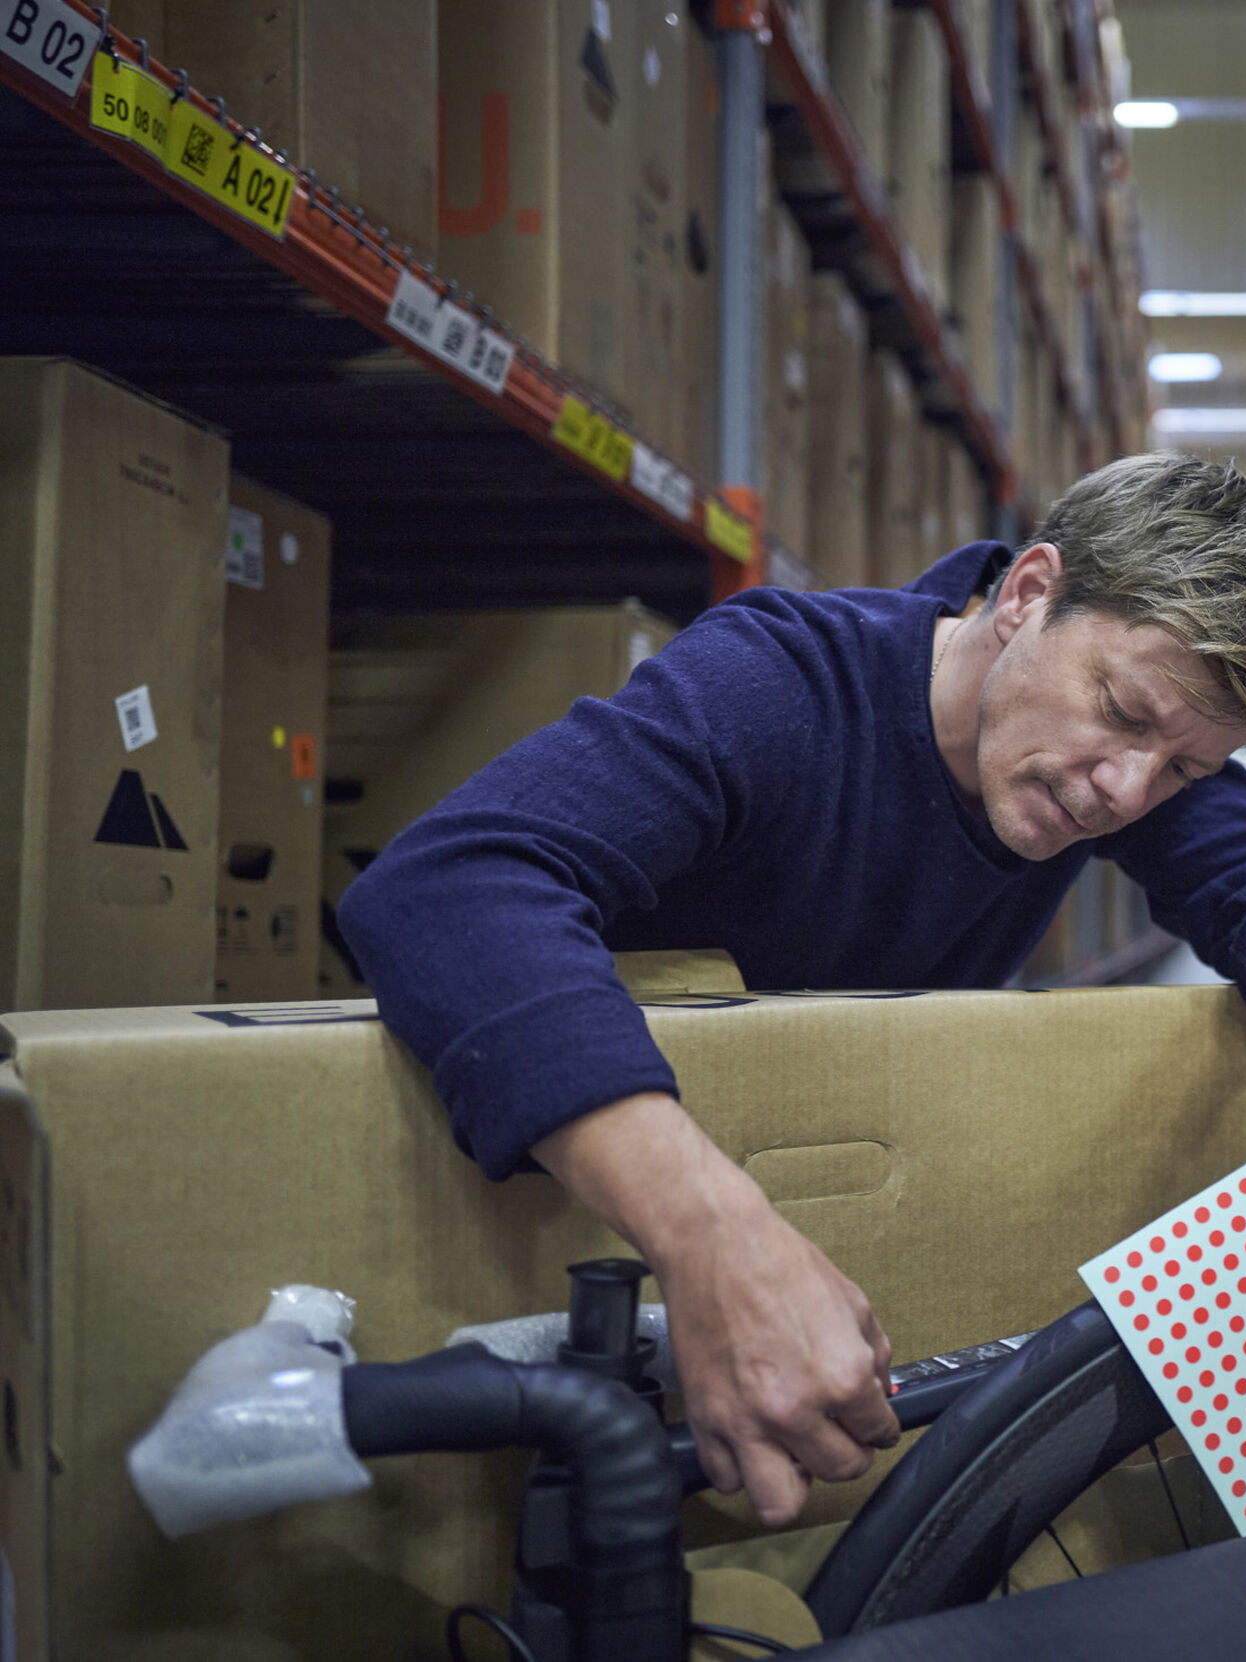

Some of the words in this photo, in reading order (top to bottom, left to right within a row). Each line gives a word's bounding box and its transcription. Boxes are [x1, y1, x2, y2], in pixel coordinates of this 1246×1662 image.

[5, 0, 39, 45] B
[40, 20, 85, 79] 02
[103, 93, 129, 121] 50
[134, 106, 149, 133] 08
[222, 154, 242, 196] A
[246, 170, 275, 216] 02
